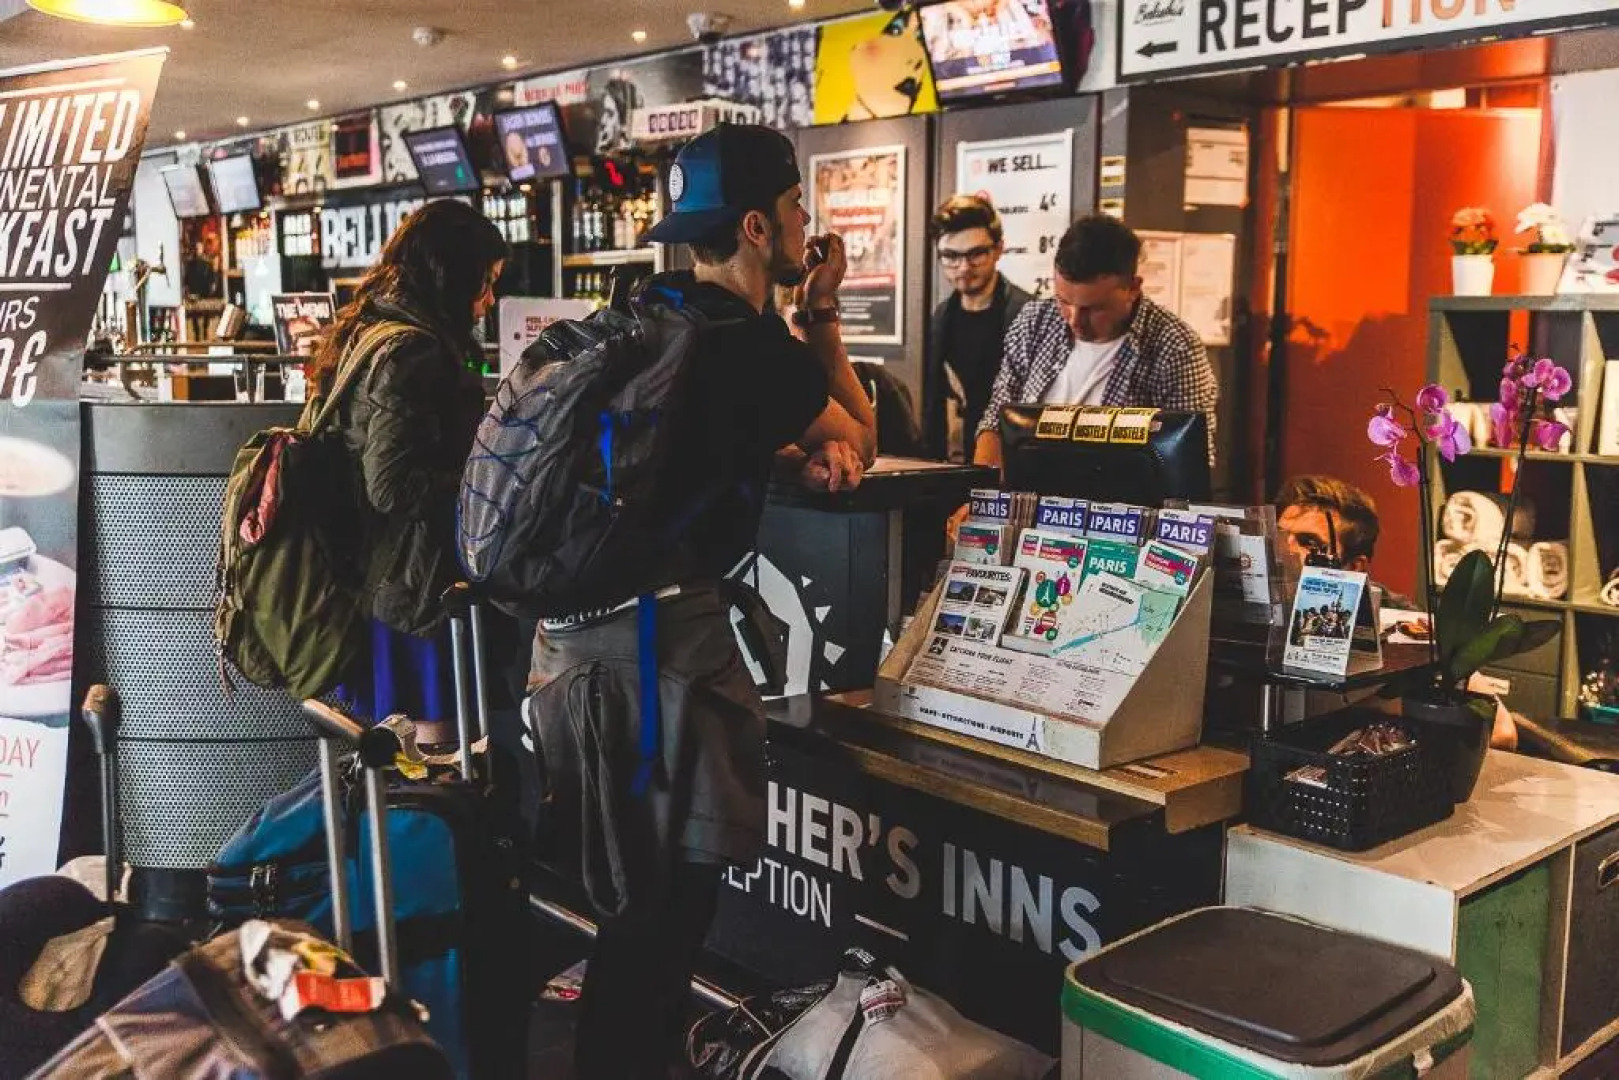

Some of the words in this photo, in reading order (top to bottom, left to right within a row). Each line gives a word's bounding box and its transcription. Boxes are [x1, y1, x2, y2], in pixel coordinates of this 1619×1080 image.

[1198, 0, 1515, 54] RECEP
[0, 90, 140, 169] IMITED
[987, 157, 1008, 174] WE
[0, 164, 116, 210] NENTAL
[972, 500, 1008, 517] PARIS
[1042, 508, 1083, 527] PARIS
[1160, 522, 1207, 544] PARIS
[1088, 556, 1127, 574] PARIS
[767, 780, 921, 900] HER'S
[942, 842, 1102, 962] INNS
[722, 858, 831, 928] EPTION
